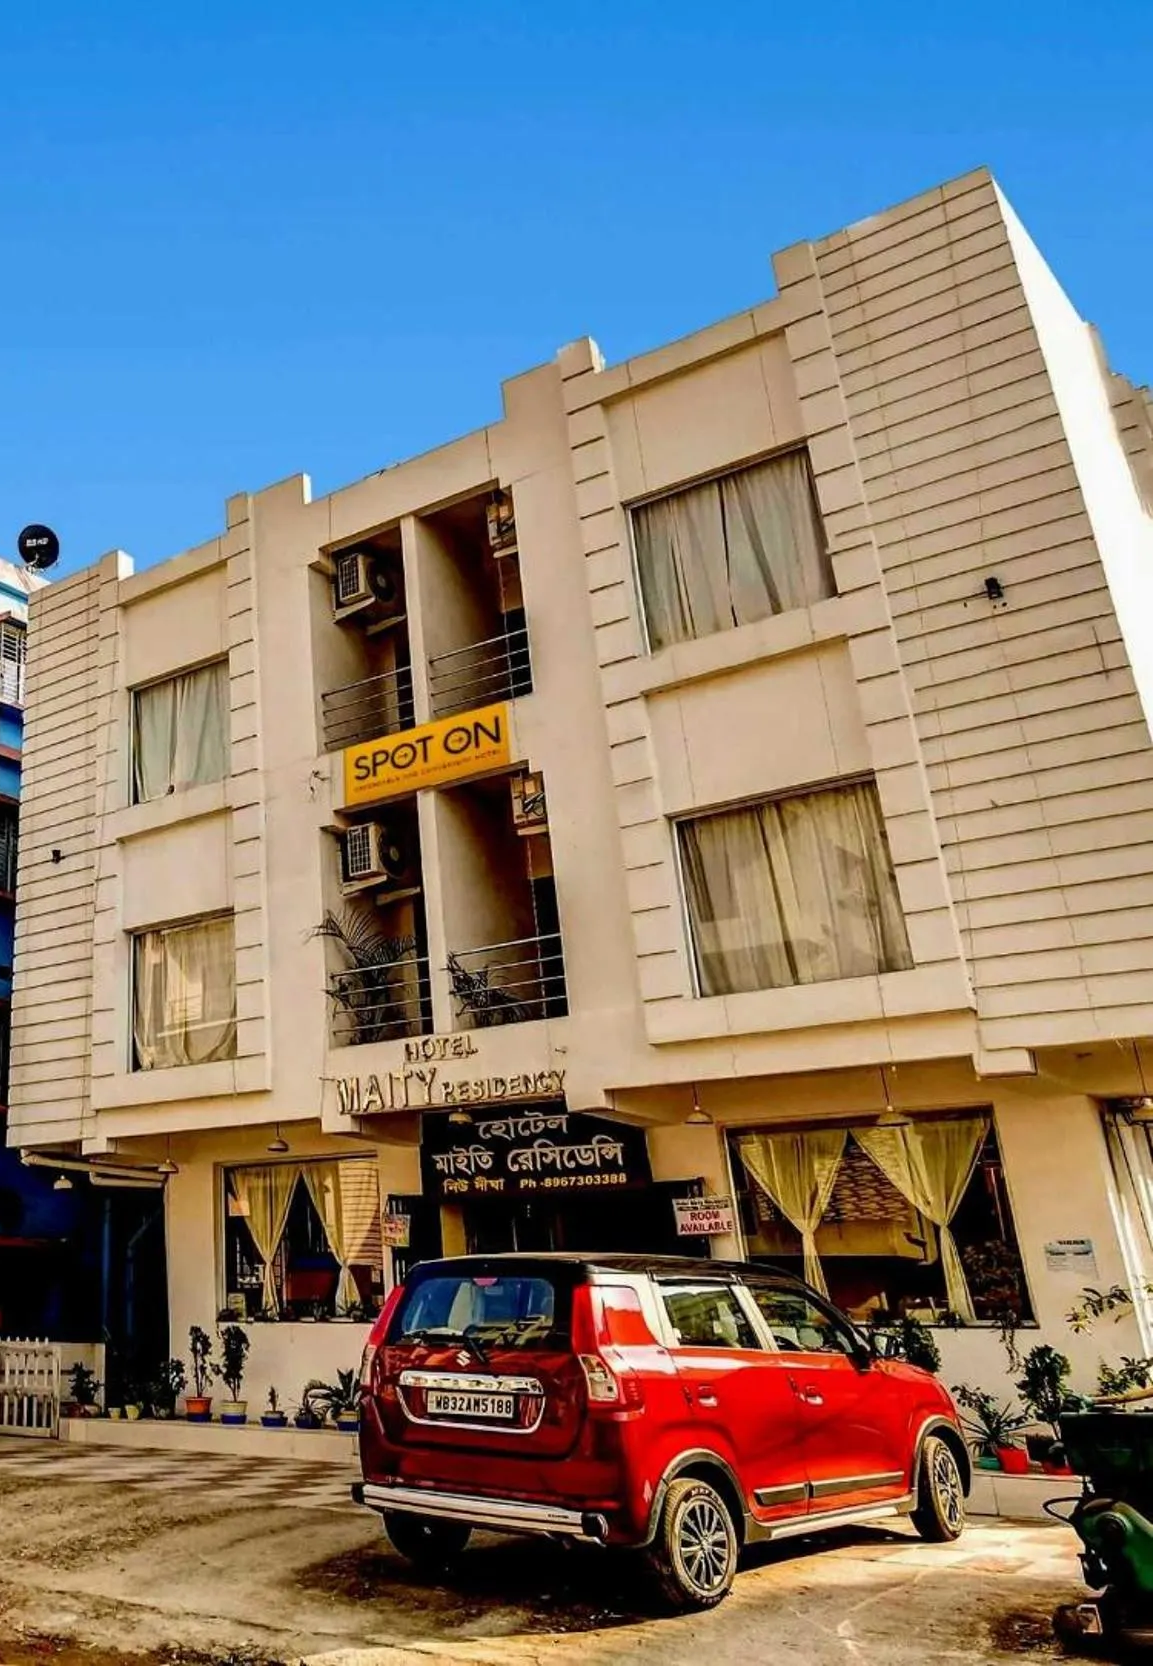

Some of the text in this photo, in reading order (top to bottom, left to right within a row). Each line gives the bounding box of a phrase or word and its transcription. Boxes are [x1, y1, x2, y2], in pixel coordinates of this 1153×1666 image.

[354, 735, 434, 780] SPOT
[443, 716, 501, 754] ON
[404, 1034, 479, 1062] HOTEL
[336, 1067, 566, 1115] MAITY RESIDENCY
[477, 1110, 569, 1140] হোটেল
[432, 1134, 624, 1175] মাইতি রেসিডেন্সি
[519, 1178, 537, 1190] Ph
[680, 1220, 732, 1232] AVAILABLE
[690, 1210, 720, 1221] ROOM
